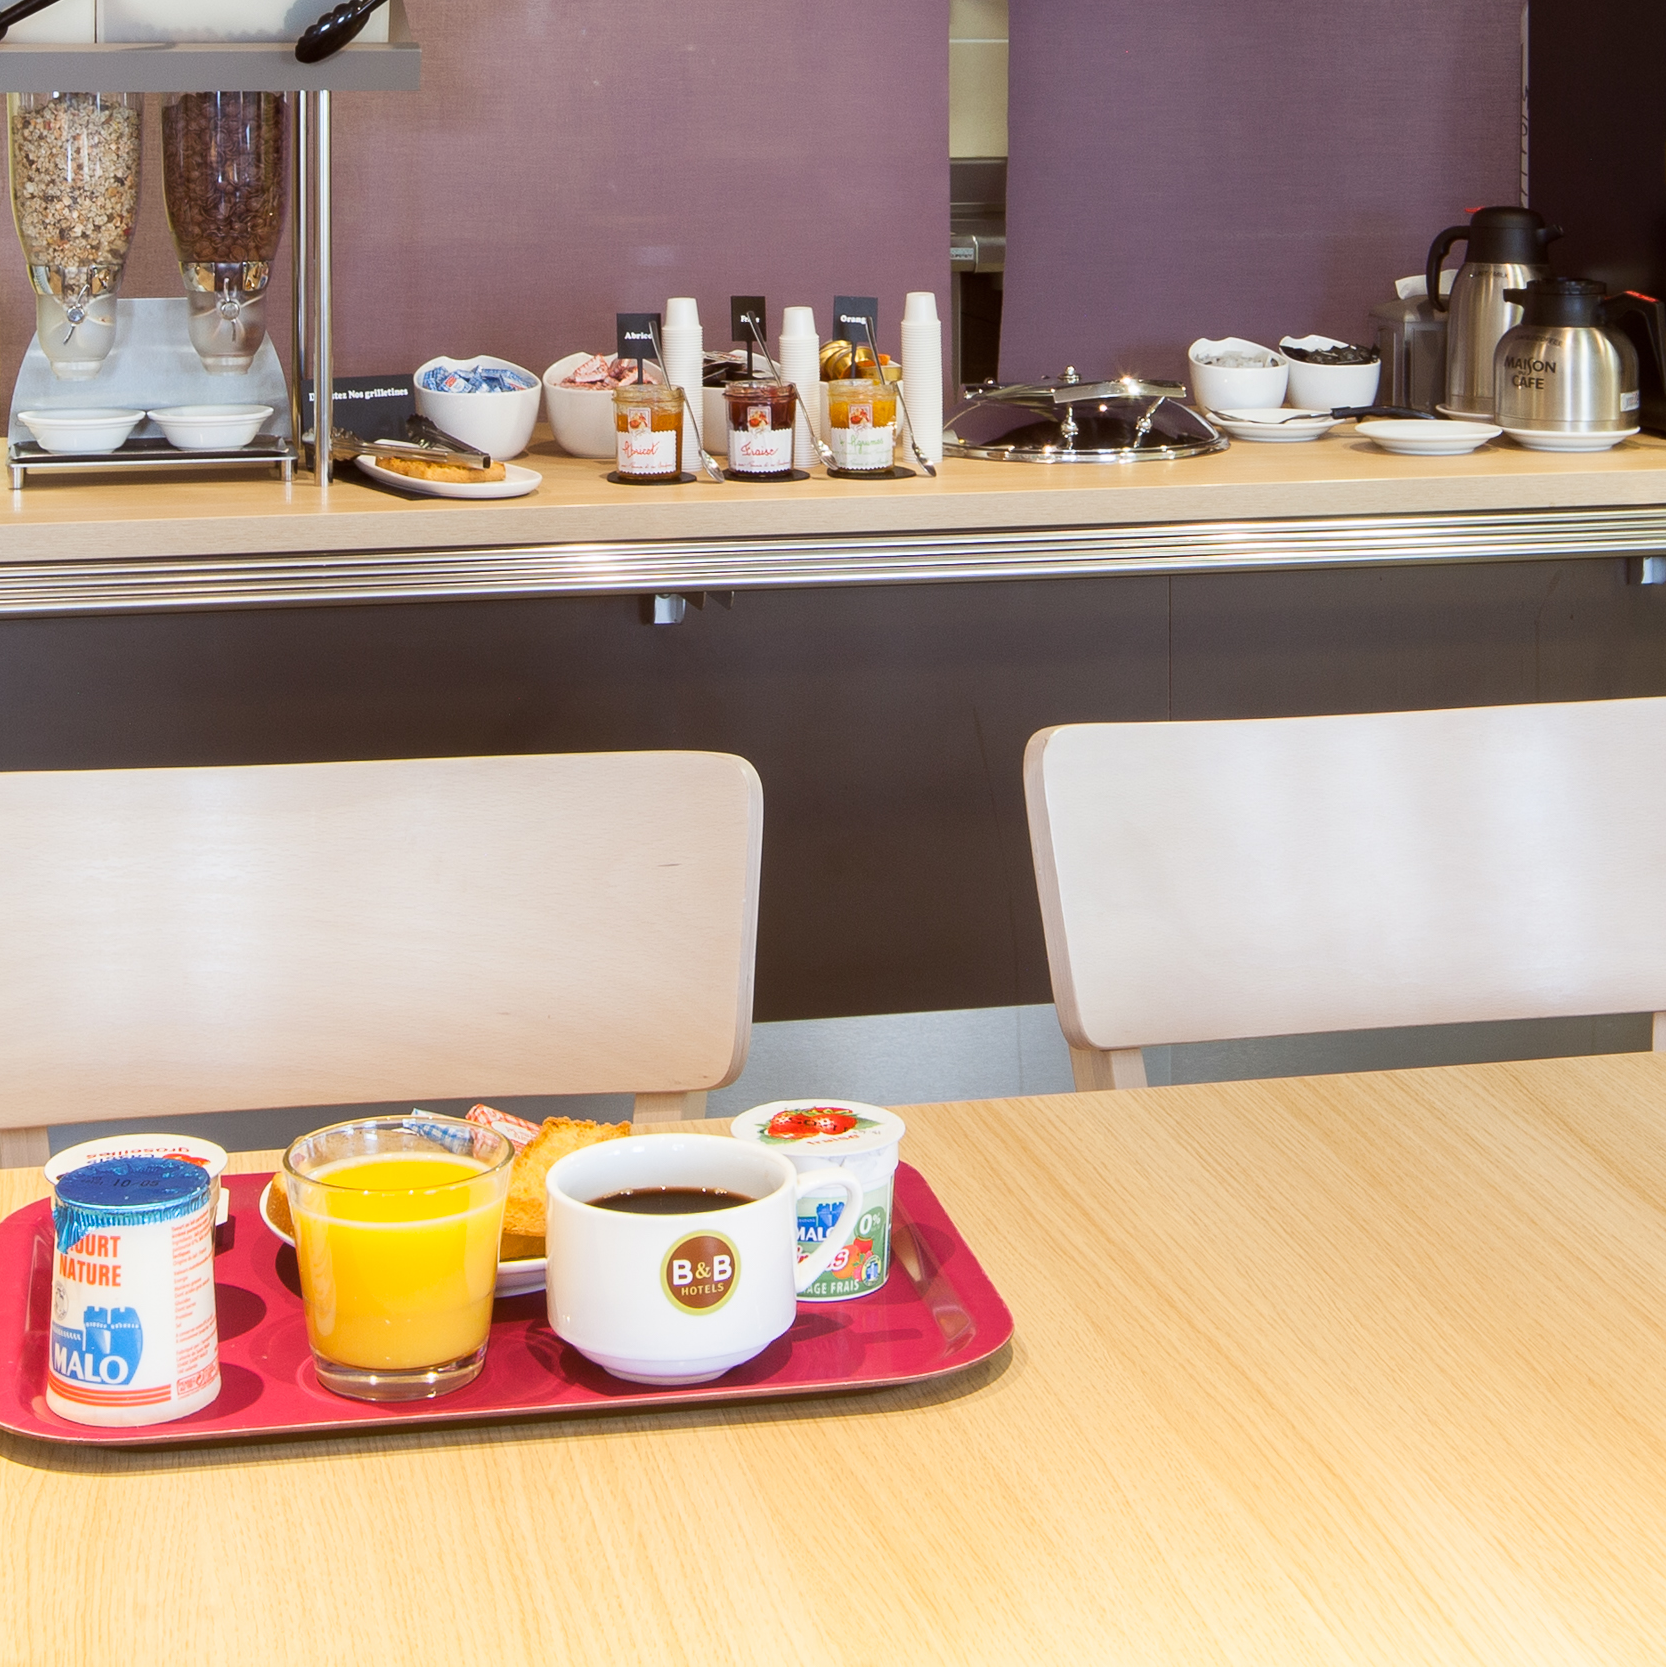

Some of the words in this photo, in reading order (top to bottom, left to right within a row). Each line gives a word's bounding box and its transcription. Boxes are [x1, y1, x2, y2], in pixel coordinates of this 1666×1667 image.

[1505, 355, 1557, 375] MAISON
[348, 390, 364, 399] Nos
[59, 1253, 122, 1287] NATURE
[681, 1282, 725, 1296] HOTELS
[831, 1279, 860, 1293] FRAIS
[54, 1342, 129, 1384] MALO
